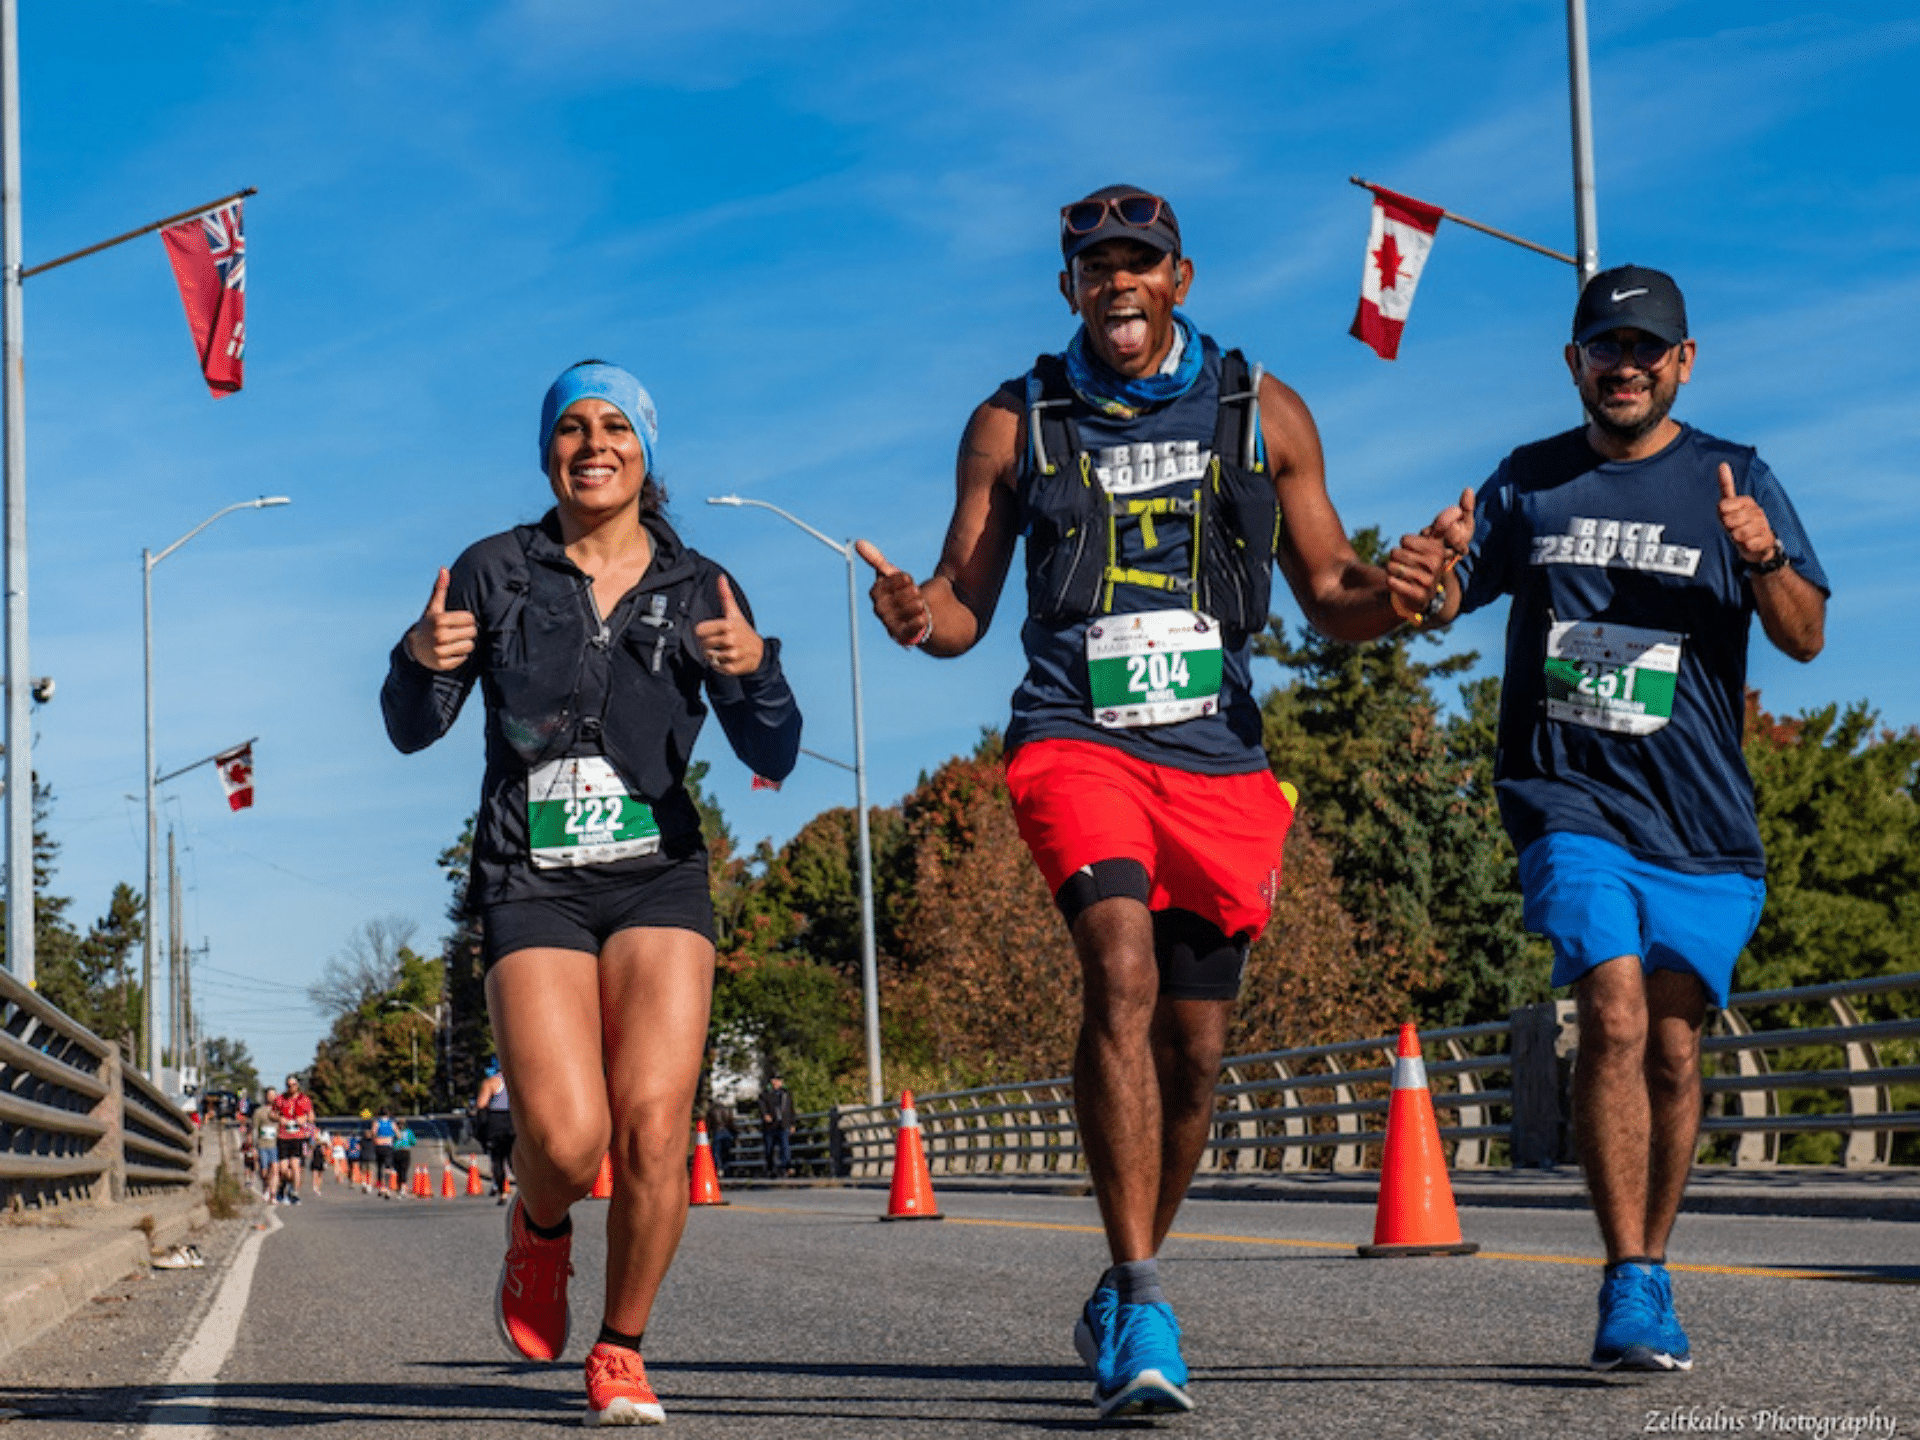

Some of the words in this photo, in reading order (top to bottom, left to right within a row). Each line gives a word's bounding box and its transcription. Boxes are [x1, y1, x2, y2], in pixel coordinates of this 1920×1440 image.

[1107, 440, 1200, 466] BACK
[1574, 517, 1666, 543] BACK
[1127, 651, 1190, 693] 204
[1577, 662, 1637, 700] 251
[564, 797, 625, 835] 222
